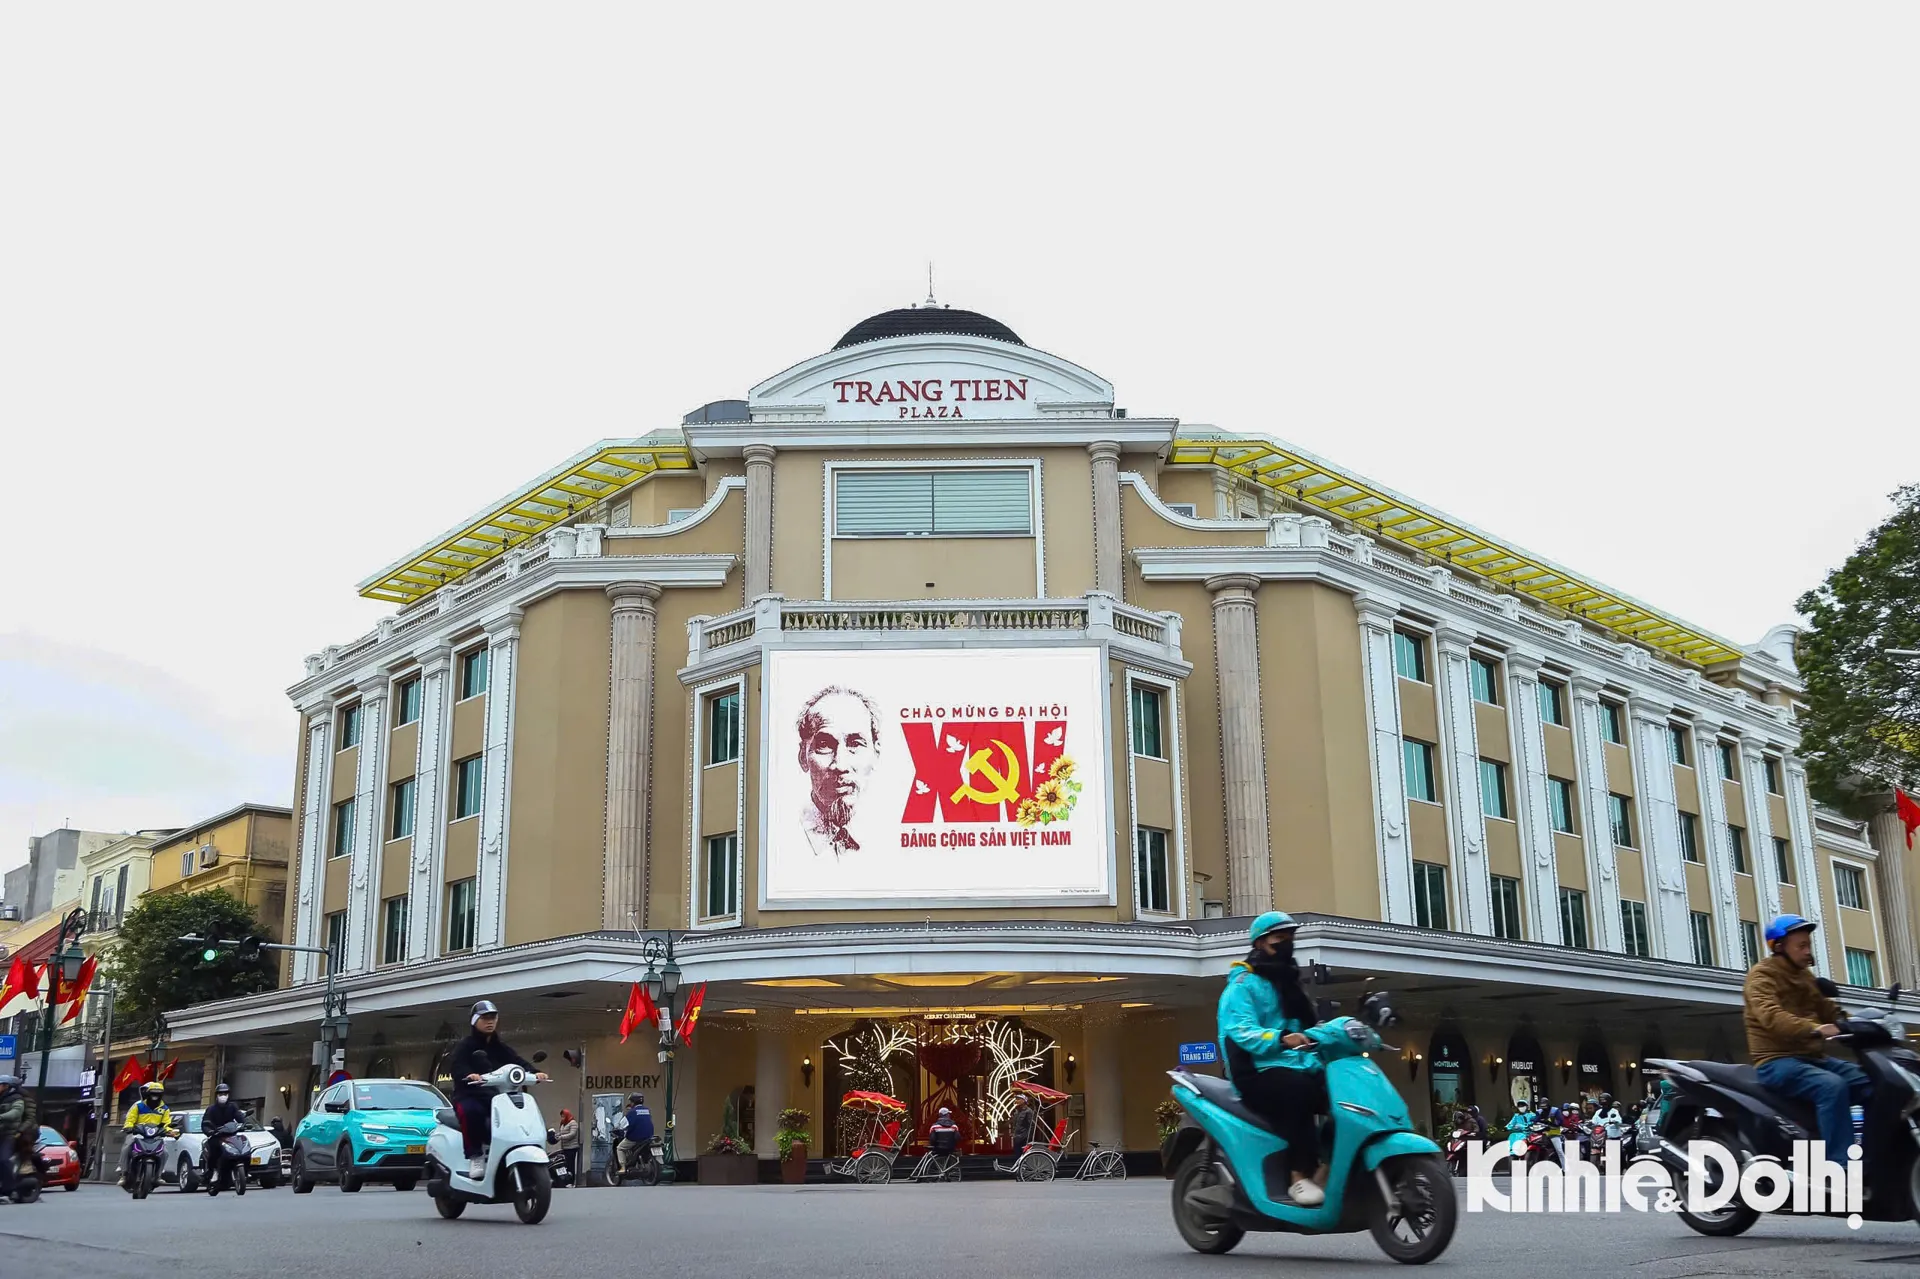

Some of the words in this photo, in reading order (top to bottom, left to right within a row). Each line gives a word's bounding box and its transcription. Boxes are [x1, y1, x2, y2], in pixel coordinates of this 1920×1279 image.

[833, 379, 943, 405] TRANG
[950, 379, 1028, 400] TIEN
[899, 406, 963, 418] PLAZA
[900, 705, 946, 718] CHÀO
[952, 704, 999, 717] MỪNG
[1005, 706, 1033, 719] ĐẠI
[1039, 704, 1067, 719] HỘI
[901, 828, 936, 847] ĐẢNG
[940, 830, 976, 850] CỘNG
[980, 827, 1006, 846] SẢN
[1010, 829, 1037, 849] VIỆT
[1041, 831, 1071, 845] NAM
[1511, 1061, 1534, 1070] HUBLOT
[585, 1075, 660, 1090] BURBERRY
